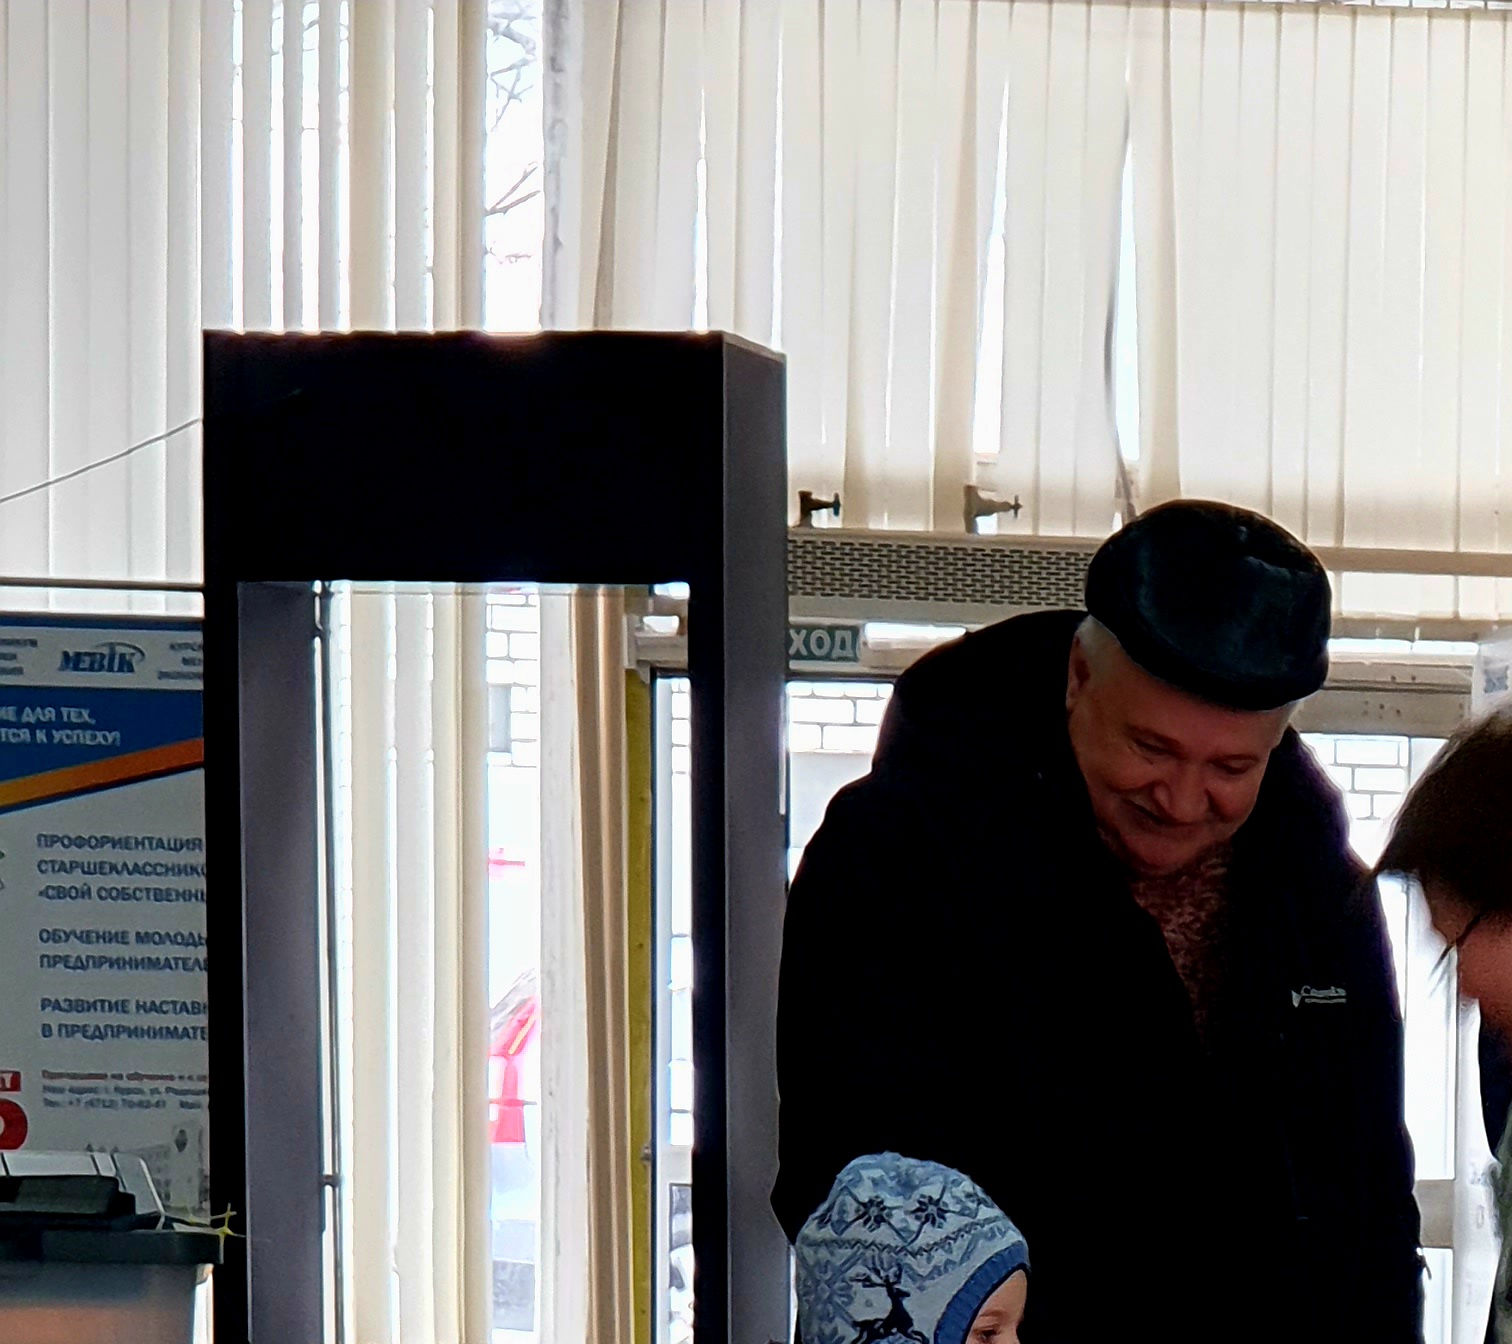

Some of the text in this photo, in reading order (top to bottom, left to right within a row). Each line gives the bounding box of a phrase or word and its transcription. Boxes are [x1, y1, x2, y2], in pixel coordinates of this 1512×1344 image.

[21, 706, 56, 724] ДЛЯ
[36, 729, 48, 744] К
[37, 833, 203, 852] ПРОФОРИЕНТАЦИЯ
[38, 928, 130, 945] ОБУЧЕНИЕ
[40, 998, 130, 1014] РАЗВИТИЕ
[41, 1023, 53, 1038] В
